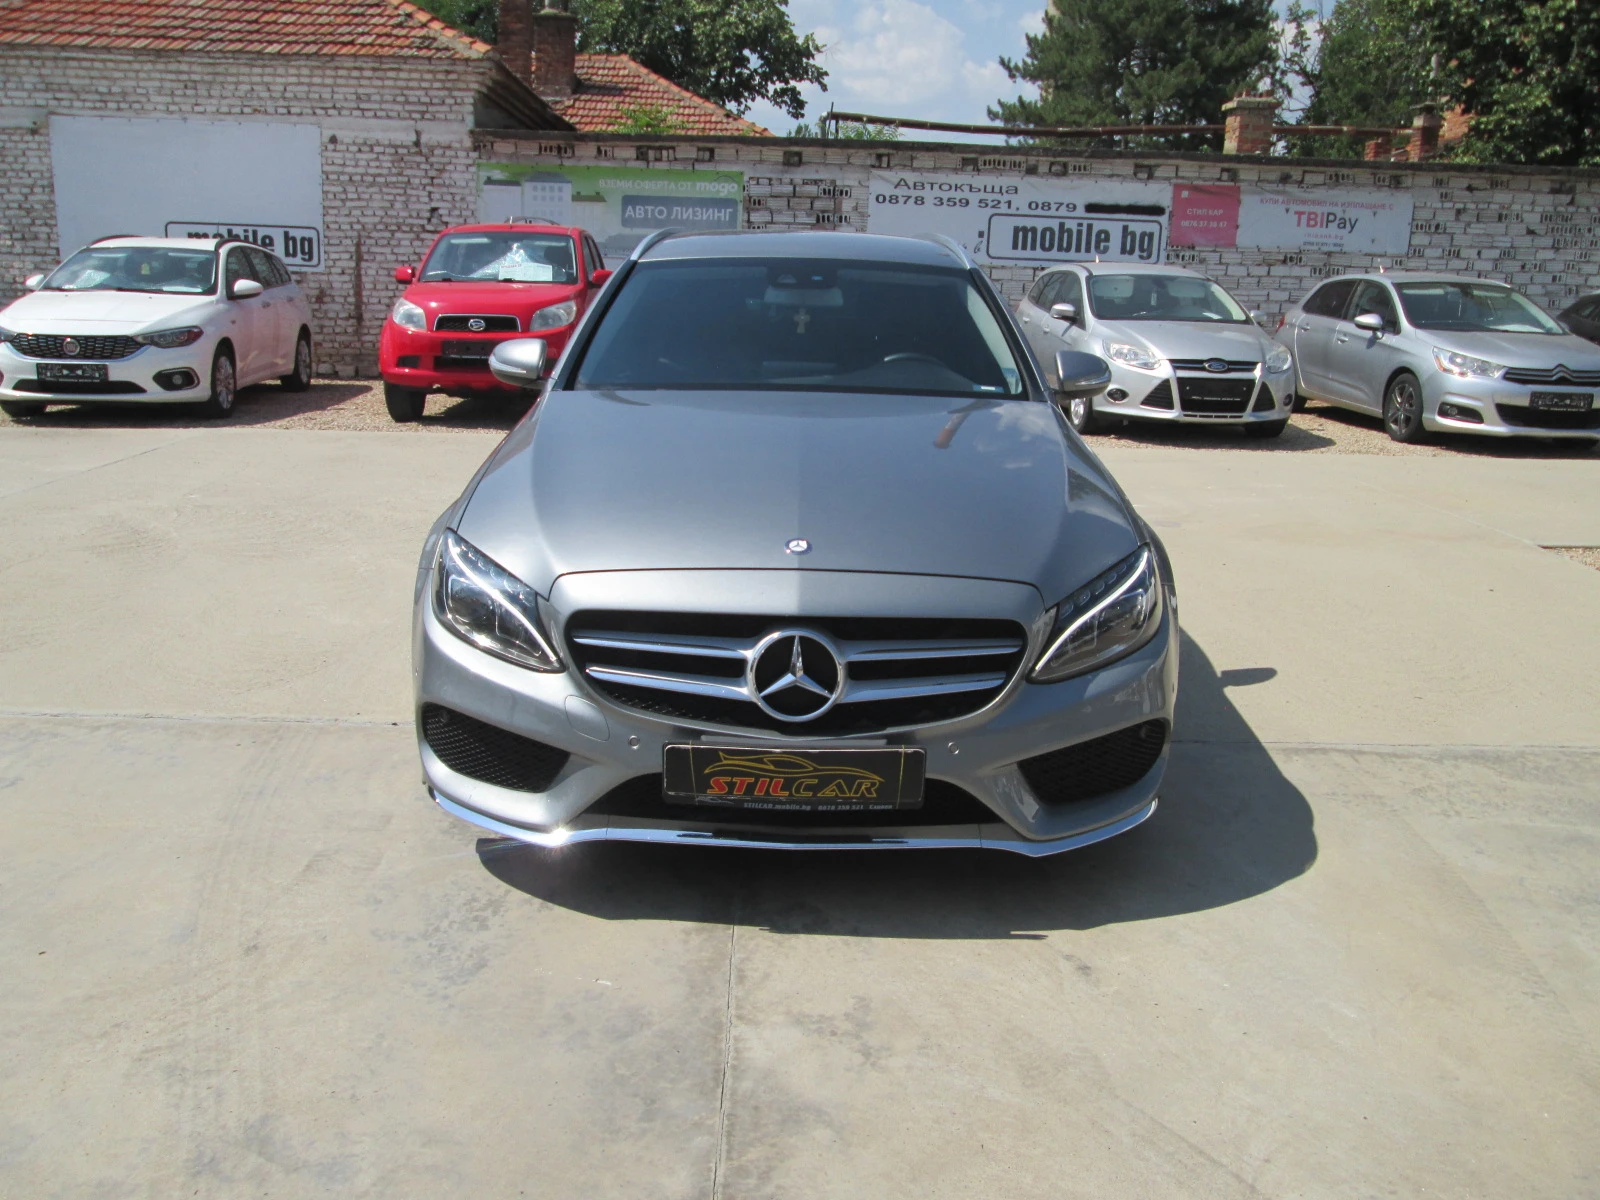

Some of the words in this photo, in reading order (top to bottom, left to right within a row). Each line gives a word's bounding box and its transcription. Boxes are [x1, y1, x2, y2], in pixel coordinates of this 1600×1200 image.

[599, 179, 632, 189] ВЗЕМИ
[634, 180, 676, 191] ОФЕРТА
[677, 182, 693, 191] ОТ
[696, 182, 738, 196] mogo
[894, 178, 1019, 196] Автокъща
[875, 193, 925, 206] 0878
[933, 196, 970, 208] 359
[978, 198, 1020, 211] 521,
[1027, 200, 1077, 212] 0879
[1281, 198, 1327, 207] АВТОМОБИЛ
[625, 205, 667, 219] АВТО
[670, 206, 733, 221] ЛИЗИНГ
[1294, 210, 1358, 234] TBIPay
[283, 230, 314, 262] bg
[1011, 221, 1111, 255] mobile
[1119, 224, 1155, 261] bg
[706, 776, 880, 798] STILCAR
